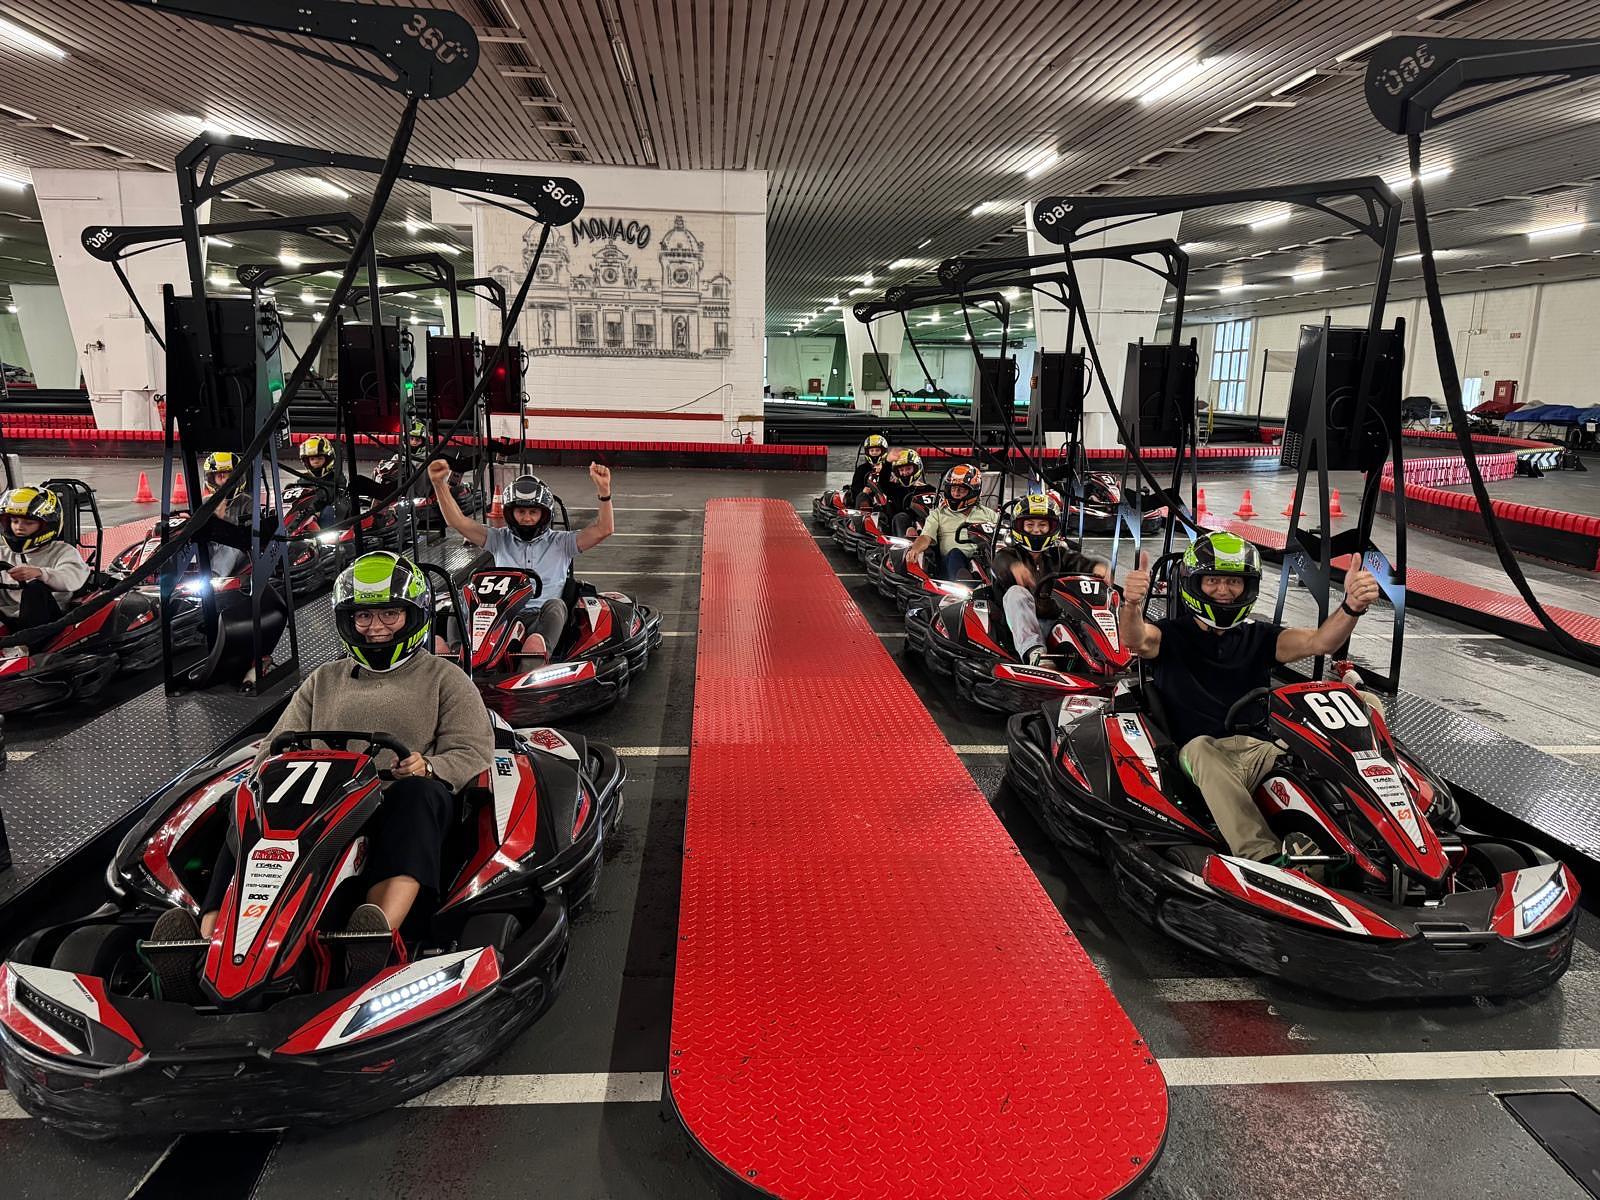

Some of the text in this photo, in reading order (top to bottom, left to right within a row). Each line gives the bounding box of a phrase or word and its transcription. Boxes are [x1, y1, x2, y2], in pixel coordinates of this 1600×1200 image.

[571, 217, 651, 249] MONACO
[478, 576, 511, 595] 54
[1080, 581, 1100, 594] 87
[1304, 691, 1369, 730] 60
[266, 761, 332, 805] 71
